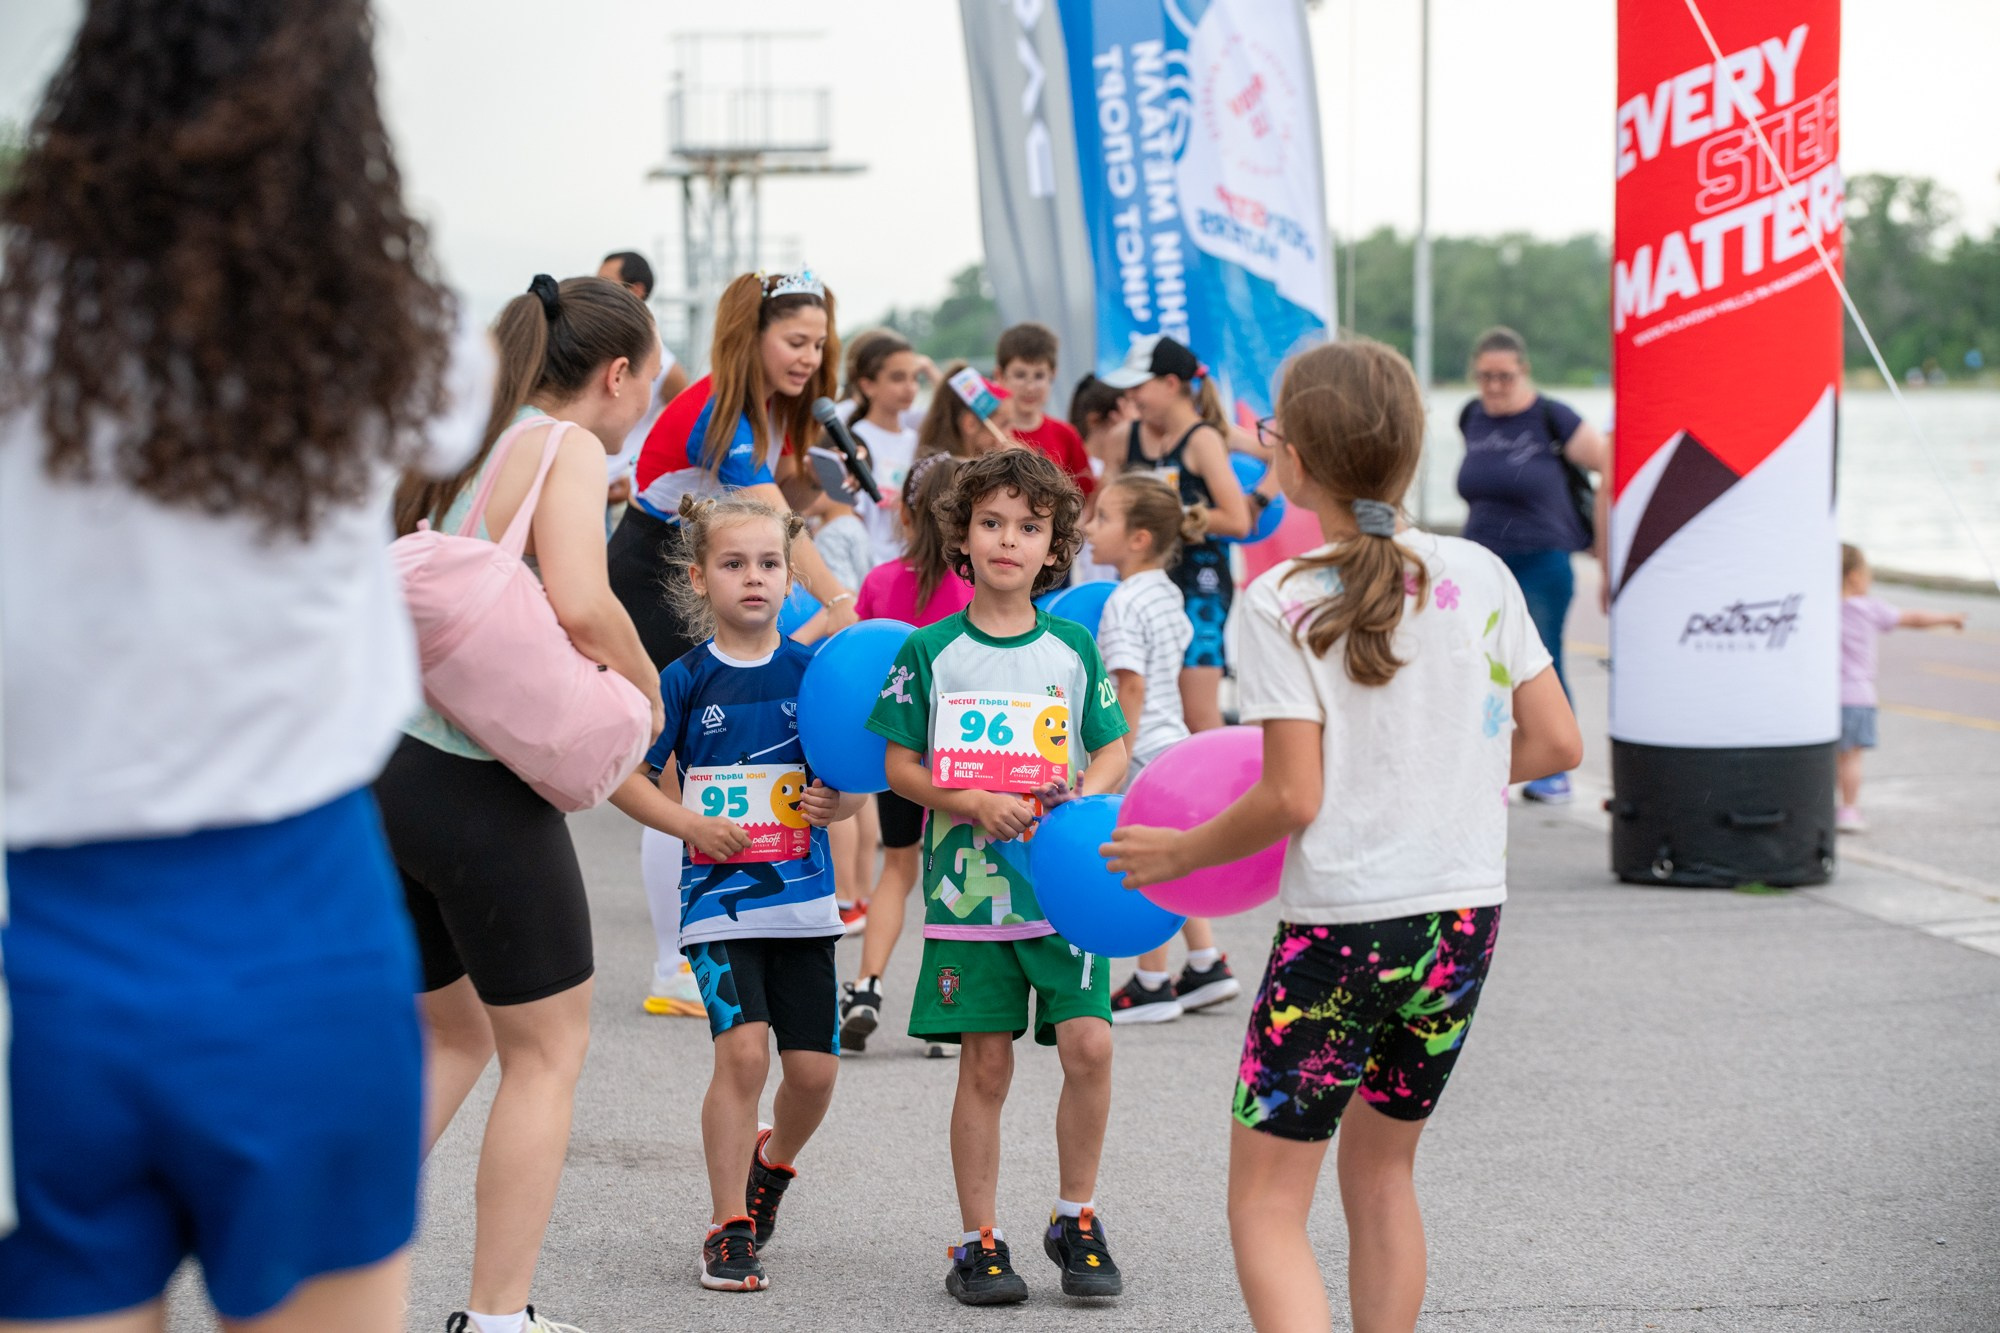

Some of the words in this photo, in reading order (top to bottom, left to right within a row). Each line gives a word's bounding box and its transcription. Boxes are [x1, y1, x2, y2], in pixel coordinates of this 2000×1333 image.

[1616, 24, 1808, 181] EVERY
[960, 710, 1014, 746] 96
[954, 761, 984, 771] PLOVDIV
[954, 770, 974, 778] HILLS
[701, 786, 749, 818] 95
